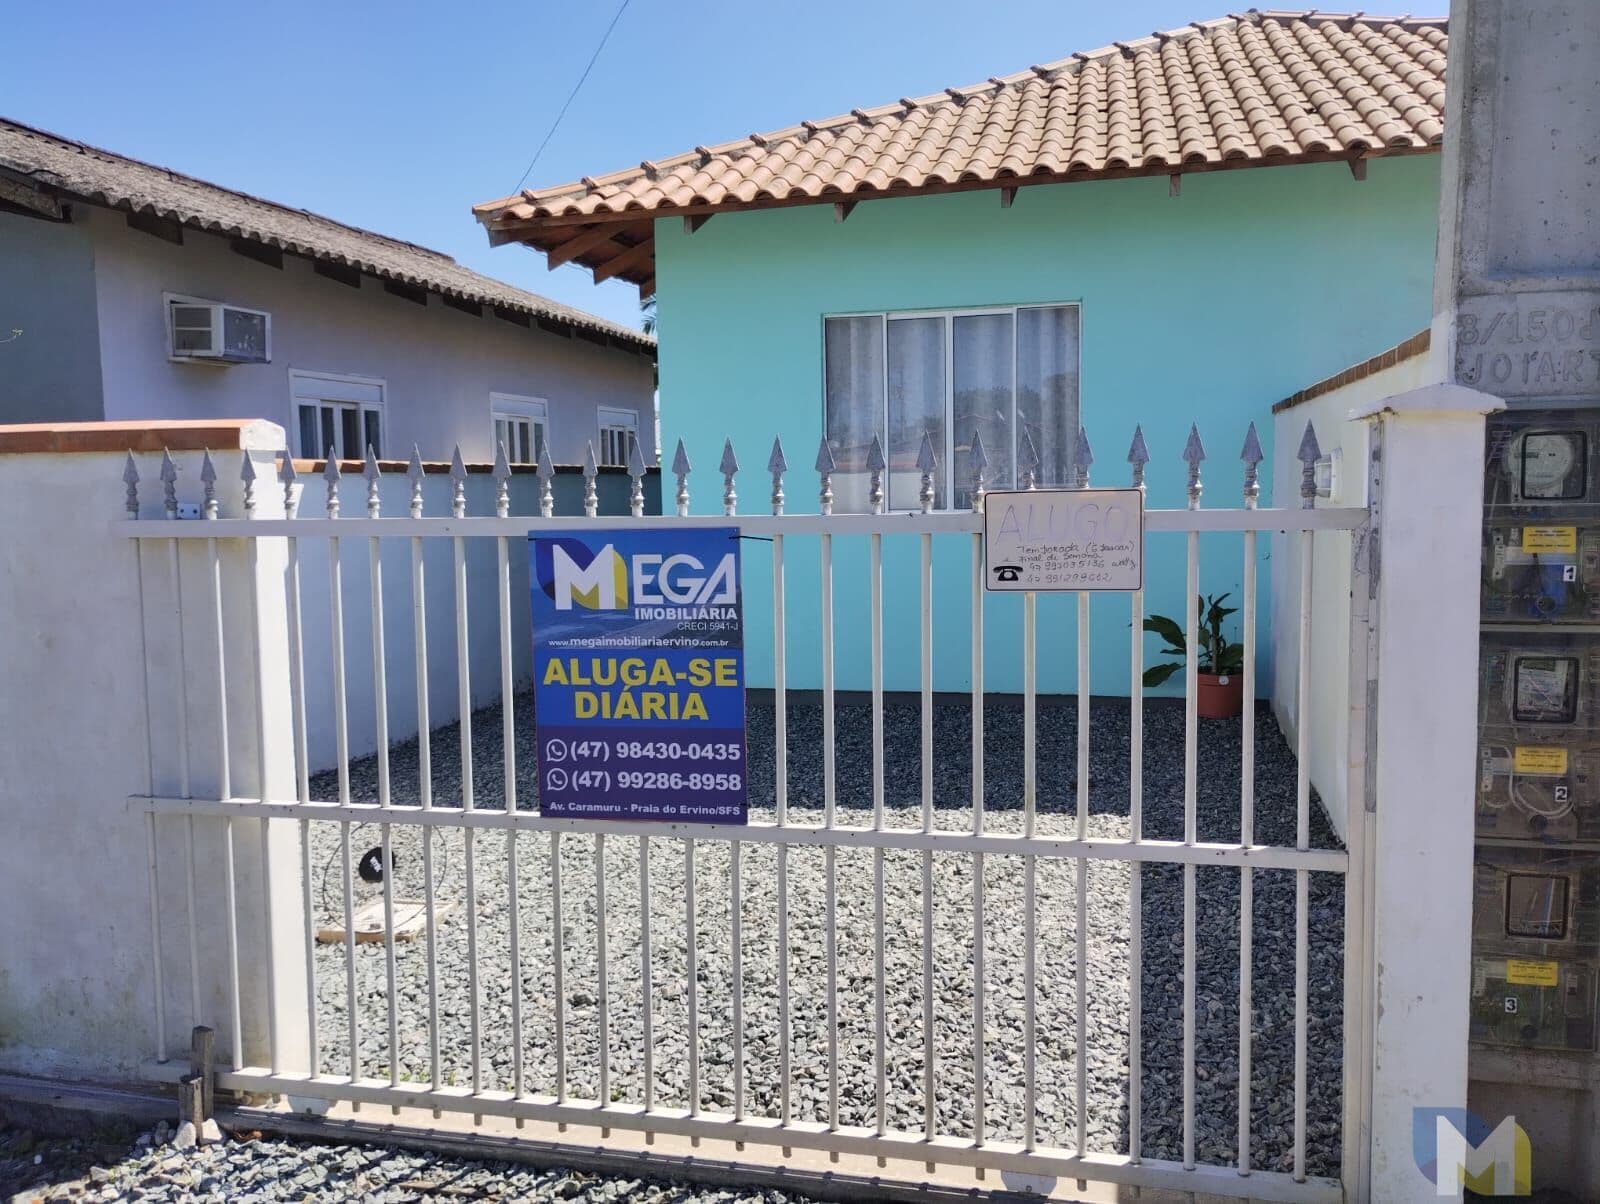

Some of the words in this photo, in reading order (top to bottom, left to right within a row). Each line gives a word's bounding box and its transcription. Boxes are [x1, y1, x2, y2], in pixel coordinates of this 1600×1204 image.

[995, 504, 1129, 546] ALUGO
[552, 543, 737, 610] MEGA
[1565, 567, 1574, 580] 1
[634, 605, 738, 620] IMOBILIÁRIA
[677, 621, 707, 631] CRECI
[709, 622, 739, 631] 5941-J
[548, 635, 729, 648] www.megaimobiliariaervino.com.br
[543, 657, 738, 687] ALUGA-SE
[574, 685, 709, 720] DIÁRIA
[570, 740, 610, 761] (47)
[616, 742, 741, 760] 98430-0435
[571, 770, 611, 791] (47)
[617, 771, 742, 791] 99286-8958
[1556, 788, 1566, 801] 2
[549, 801, 565, 811] Av.
[568, 801, 621, 812] Caramuru
[630, 803, 660, 813] Praia
[663, 804, 677, 814] do
[679, 805, 741, 816] Ervino/SFS
[1506, 998, 1516, 1011] 3
